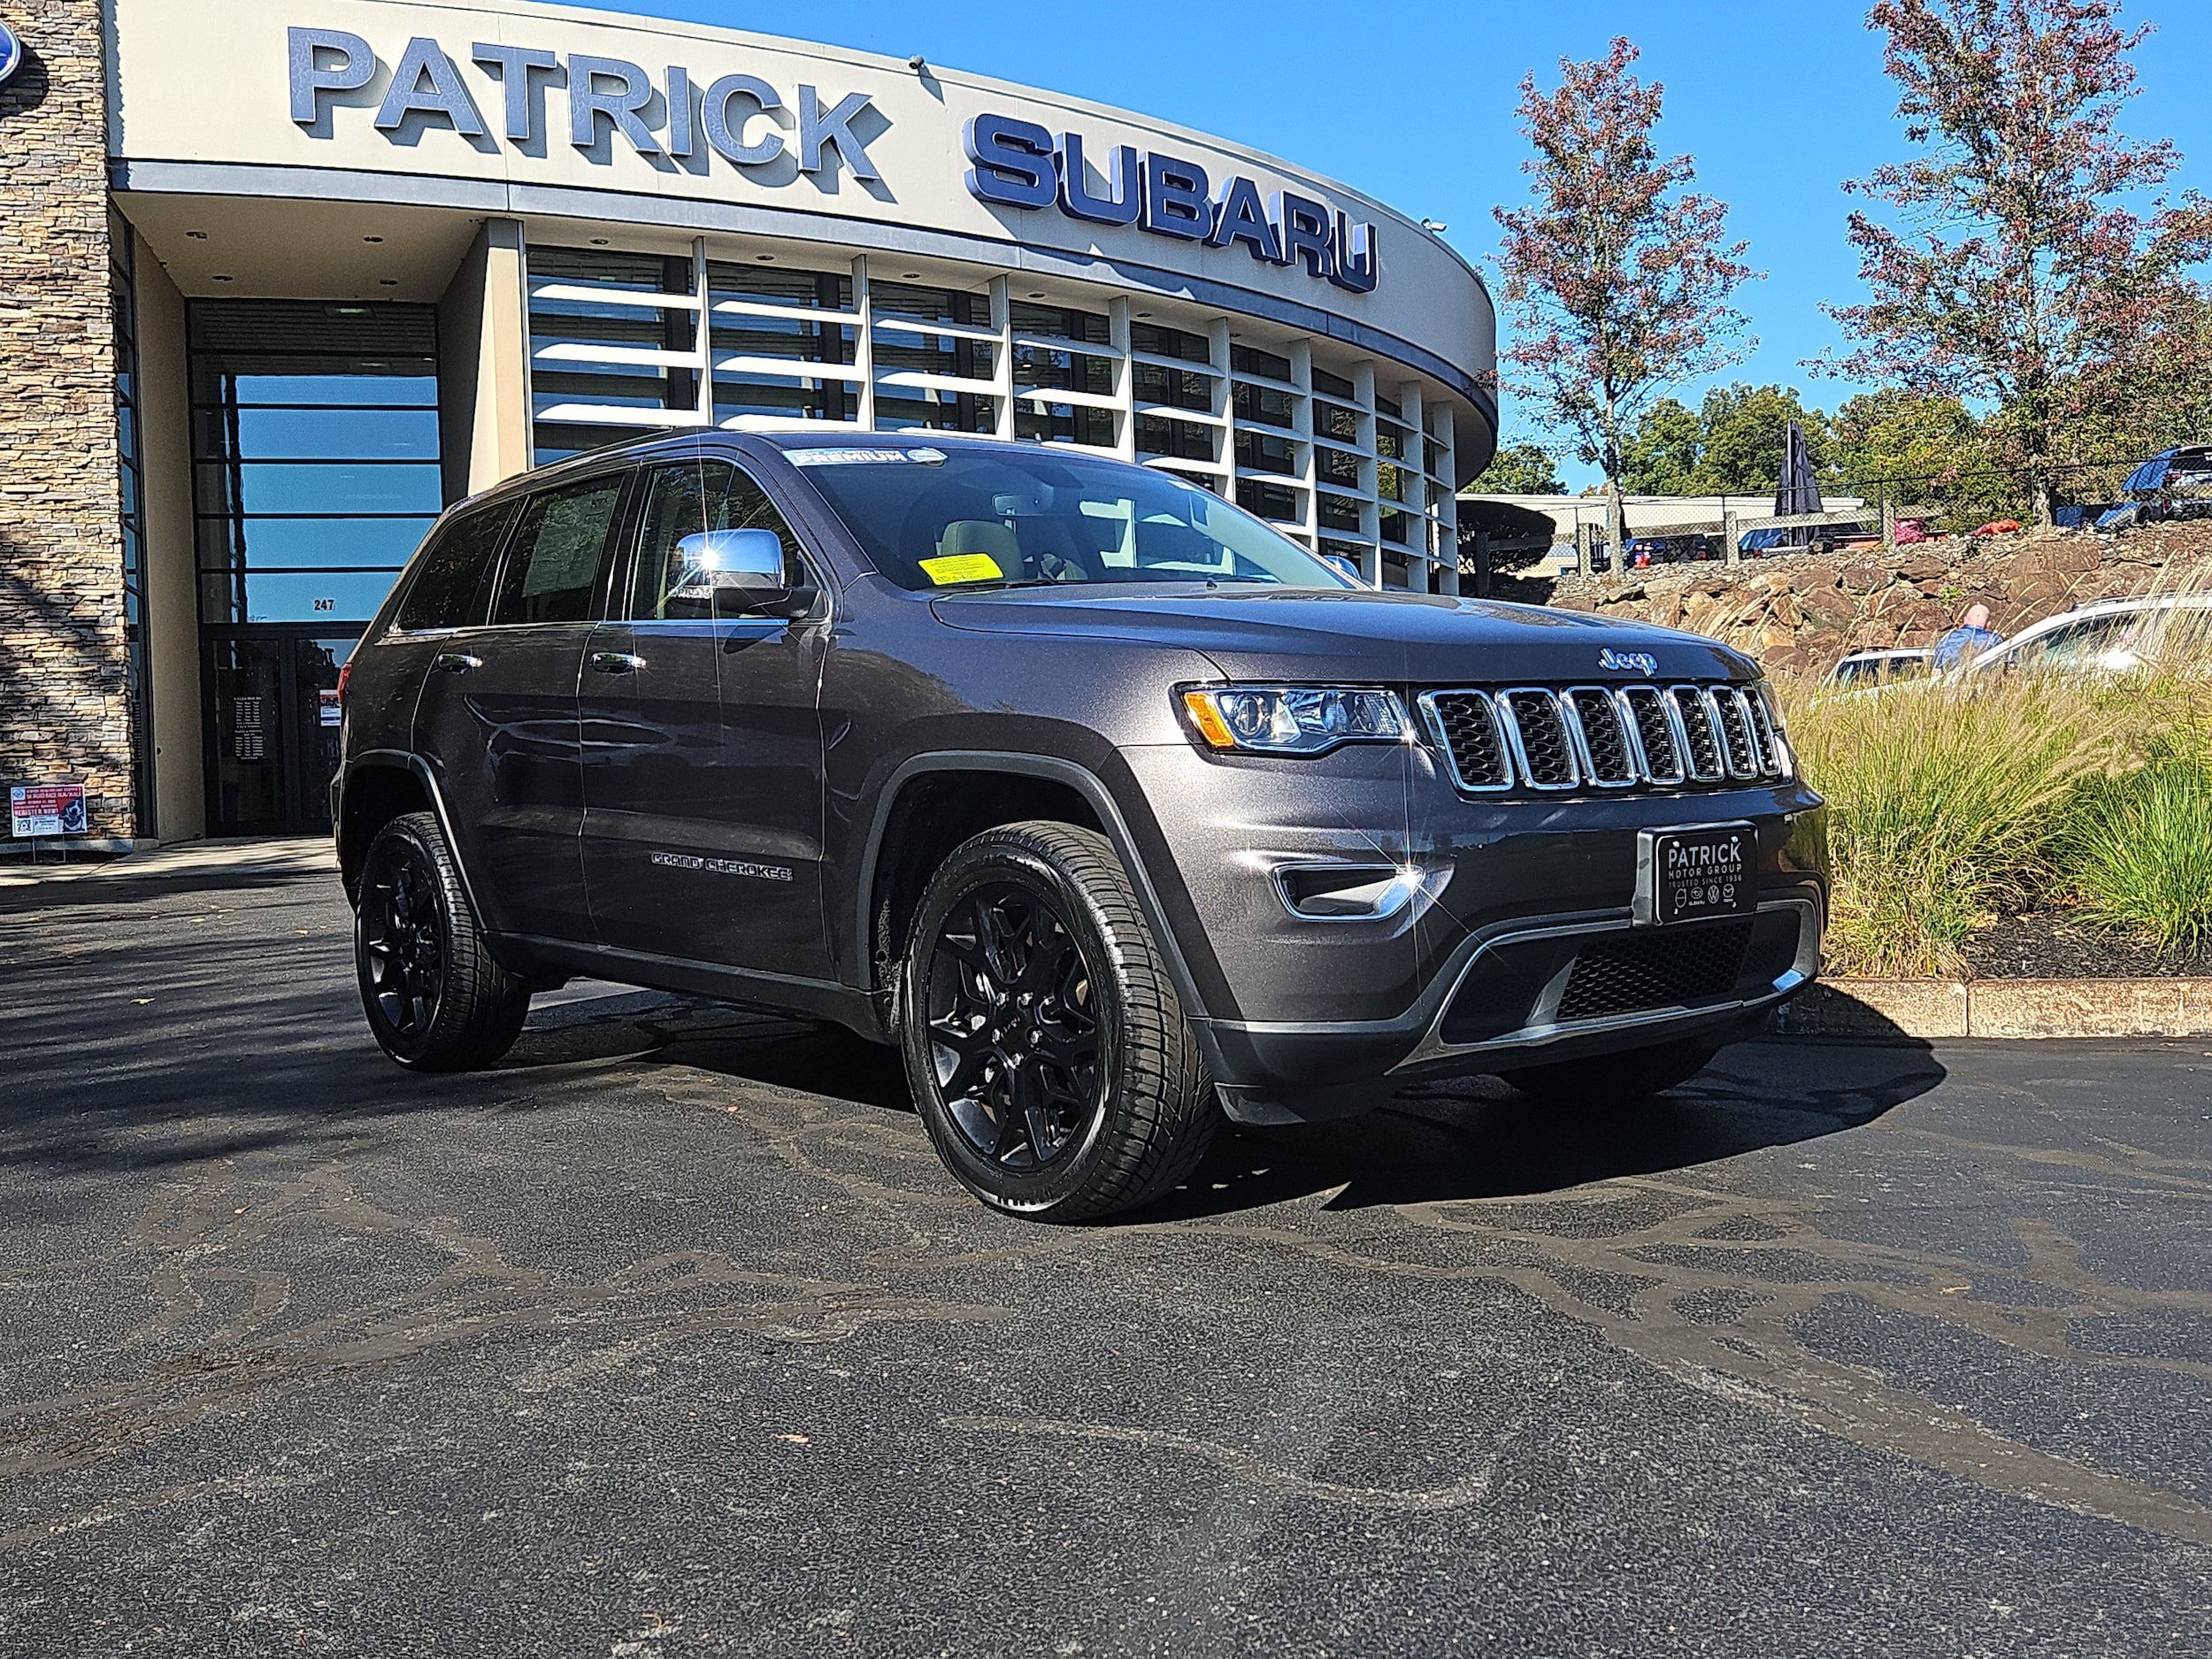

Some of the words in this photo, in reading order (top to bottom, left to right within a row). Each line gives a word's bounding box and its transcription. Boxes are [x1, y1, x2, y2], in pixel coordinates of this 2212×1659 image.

[288, 26, 879, 180] PATRICK
[964, 113, 1380, 295] SUBARU
[795, 449, 908, 464] PREMIUM
[313, 599, 334, 611] 247
[1598, 648, 1658, 677] Jeep
[1668, 842, 1742, 869] PATRICK
[651, 852, 704, 870] GRAND
[705, 858, 794, 881] CHEROKEE
[1668, 868, 1702, 879] MOTOR
[1707, 864, 1742, 875] GROUP
[1669, 879, 1700, 888] TRUSTED
[1701, 876, 1723, 886] SINCE
